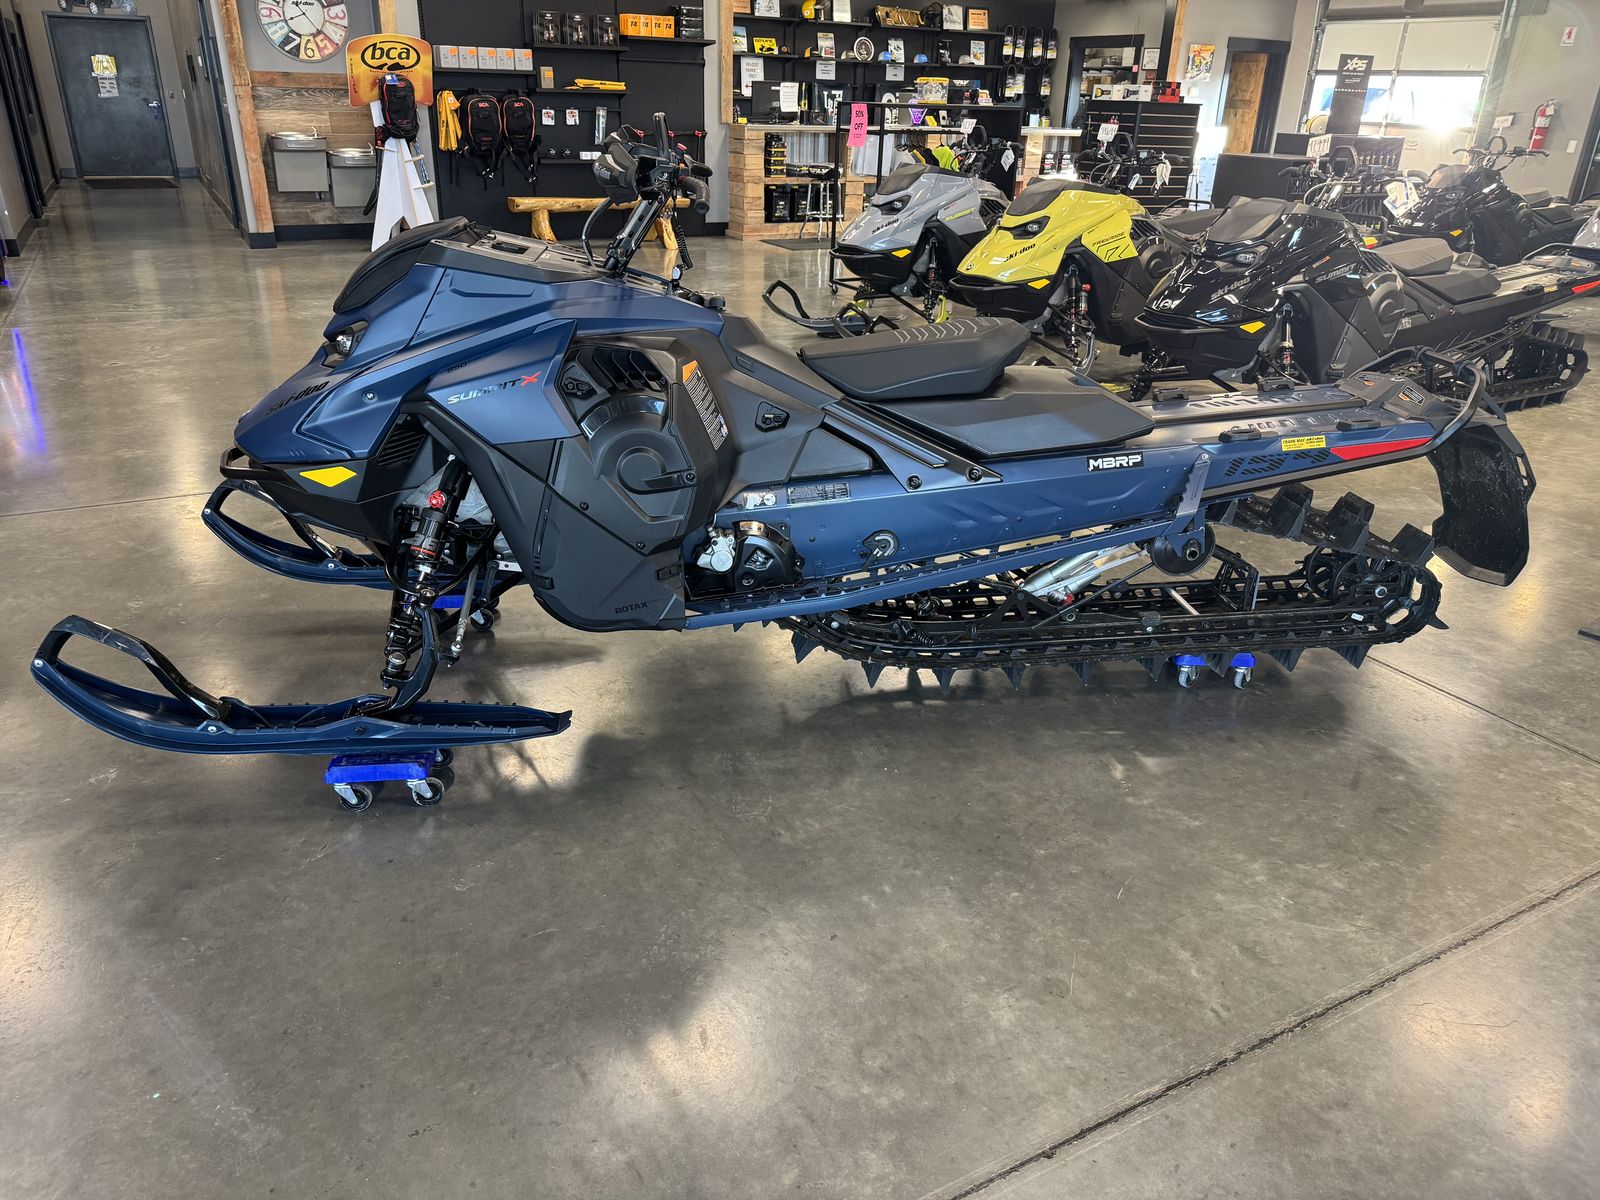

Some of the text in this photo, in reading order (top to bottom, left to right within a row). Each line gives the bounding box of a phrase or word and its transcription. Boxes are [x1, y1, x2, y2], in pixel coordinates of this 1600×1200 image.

[304, 38, 315, 58] 6
[314, 32, 334, 55] 5
[370, 41, 411, 60] bca
[1343, 57, 1369, 71] XPS
[855, 110, 865, 118] 50%
[854, 123, 864, 131] OFF
[871, 218, 900, 235] ski-doo
[1092, 231, 1126, 247] FREERIDE
[1003, 243, 1036, 263] ski-doo
[1314, 263, 1357, 284] SUMMIT
[1210, 276, 1250, 301] ski-doo
[265, 380, 331, 416] ski-doo
[1088, 454, 1142, 471] MBRP
[614, 601, 649, 614] ROTAX
